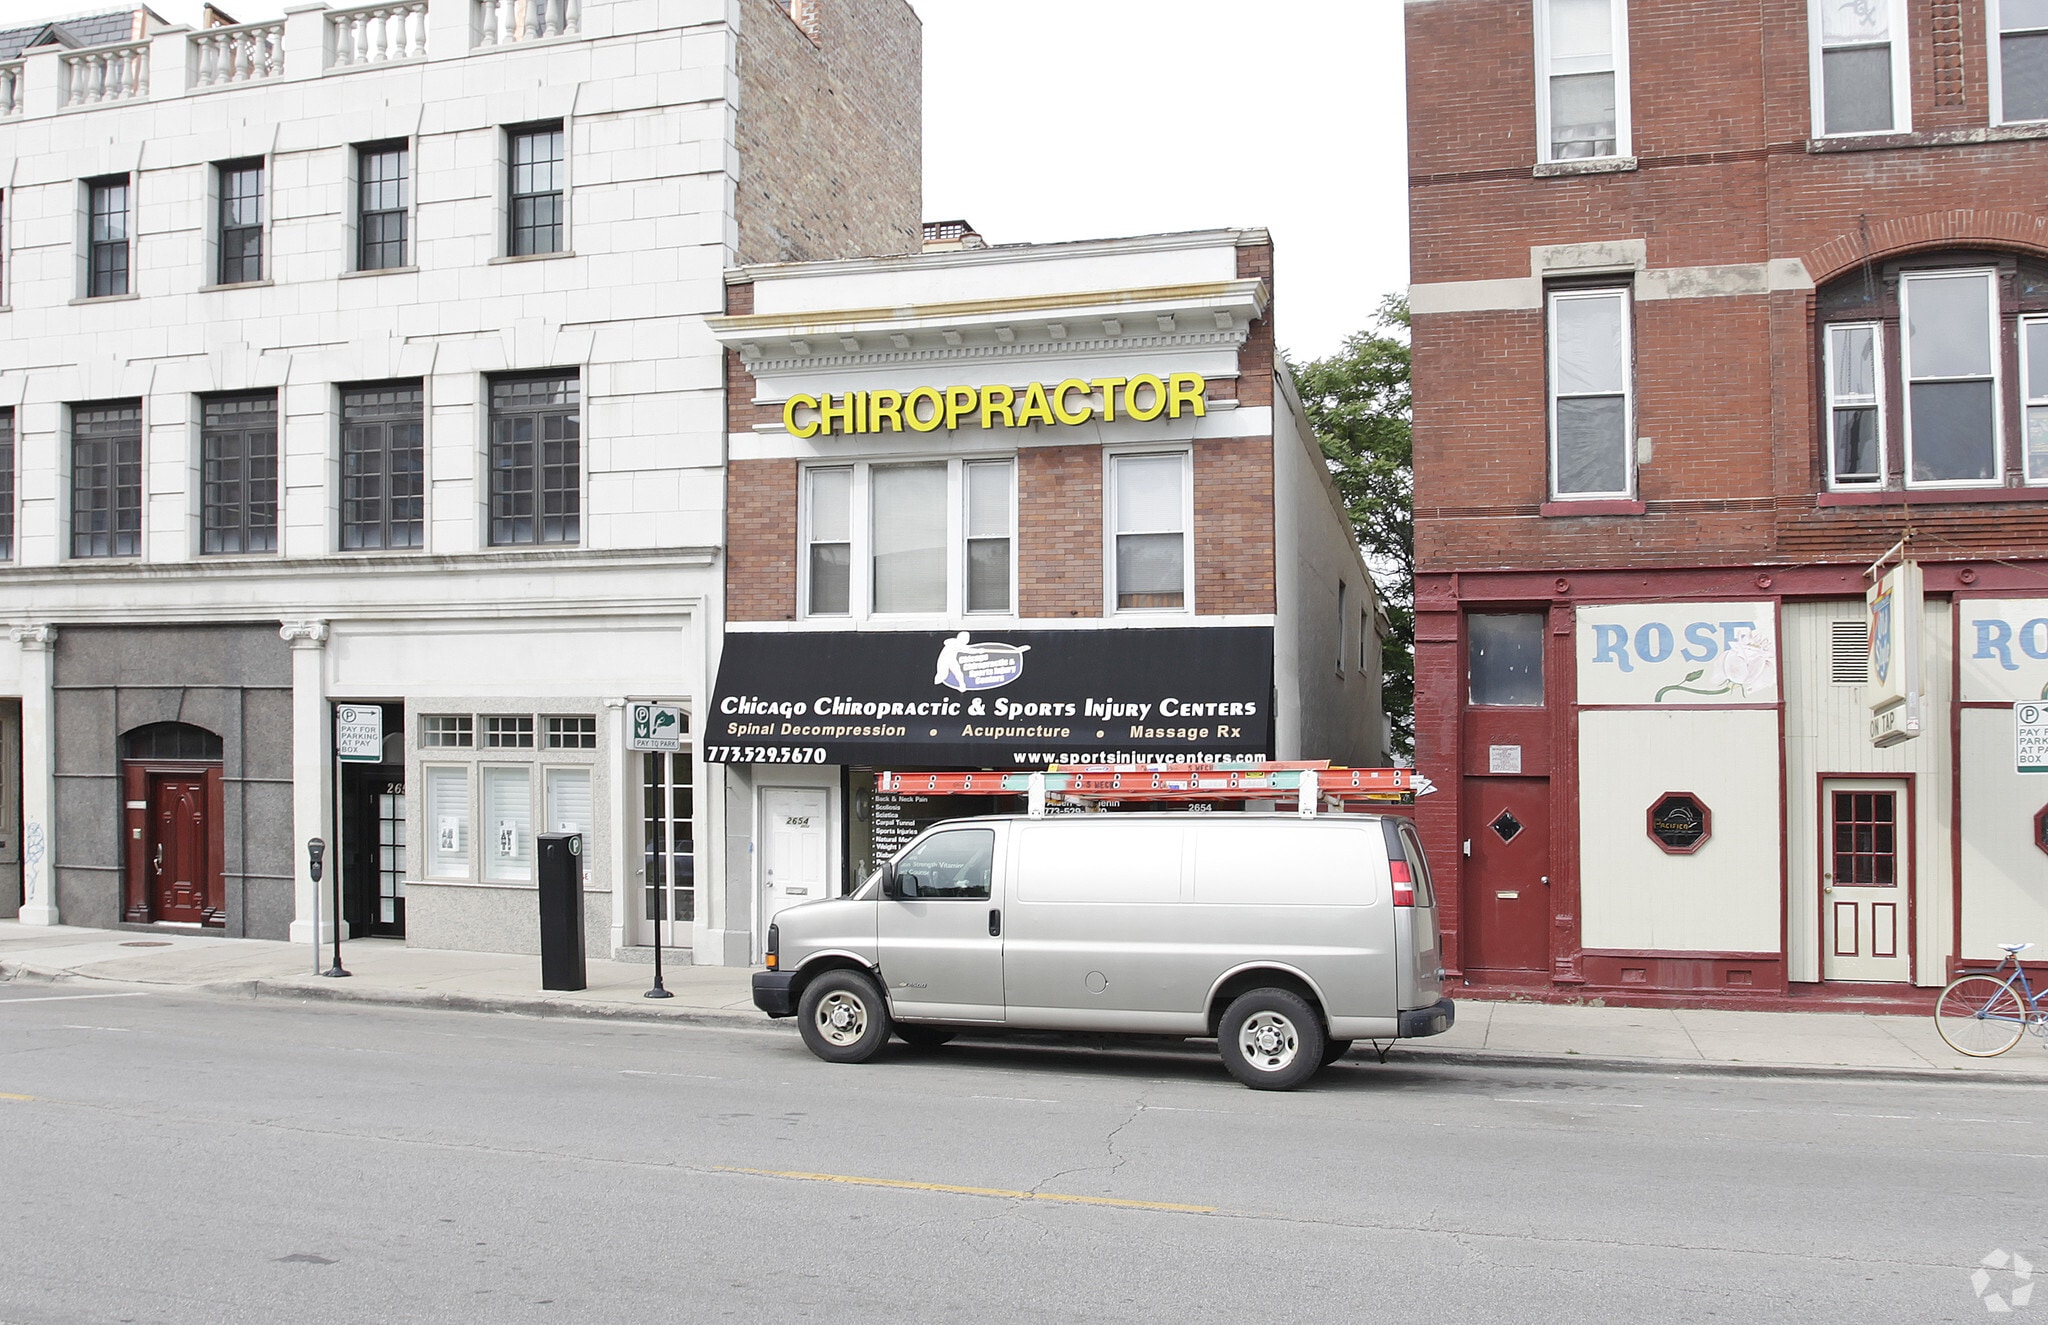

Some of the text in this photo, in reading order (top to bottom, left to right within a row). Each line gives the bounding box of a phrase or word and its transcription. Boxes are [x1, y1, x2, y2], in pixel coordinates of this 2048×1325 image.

[783, 372, 1206, 439] CHIROPRACTOR
[967, 697, 986, 715] &
[727, 722, 1241, 741] Spinal Decompression Acupuncture Massage Rx
[1870, 718, 1879, 738] ON
[1882, 711, 1895, 733] TAP
[707, 746, 827, 764] 773.529.5670
[2021, 746, 2033, 754] AT
[1013, 751, 1267, 765] www.sportsinjurycenters.com
[2020, 755, 2041, 763] BOX
[1188, 803, 1212, 812] 2654
[786, 817, 810, 825] 2654
[876, 843, 897, 851] Weight
